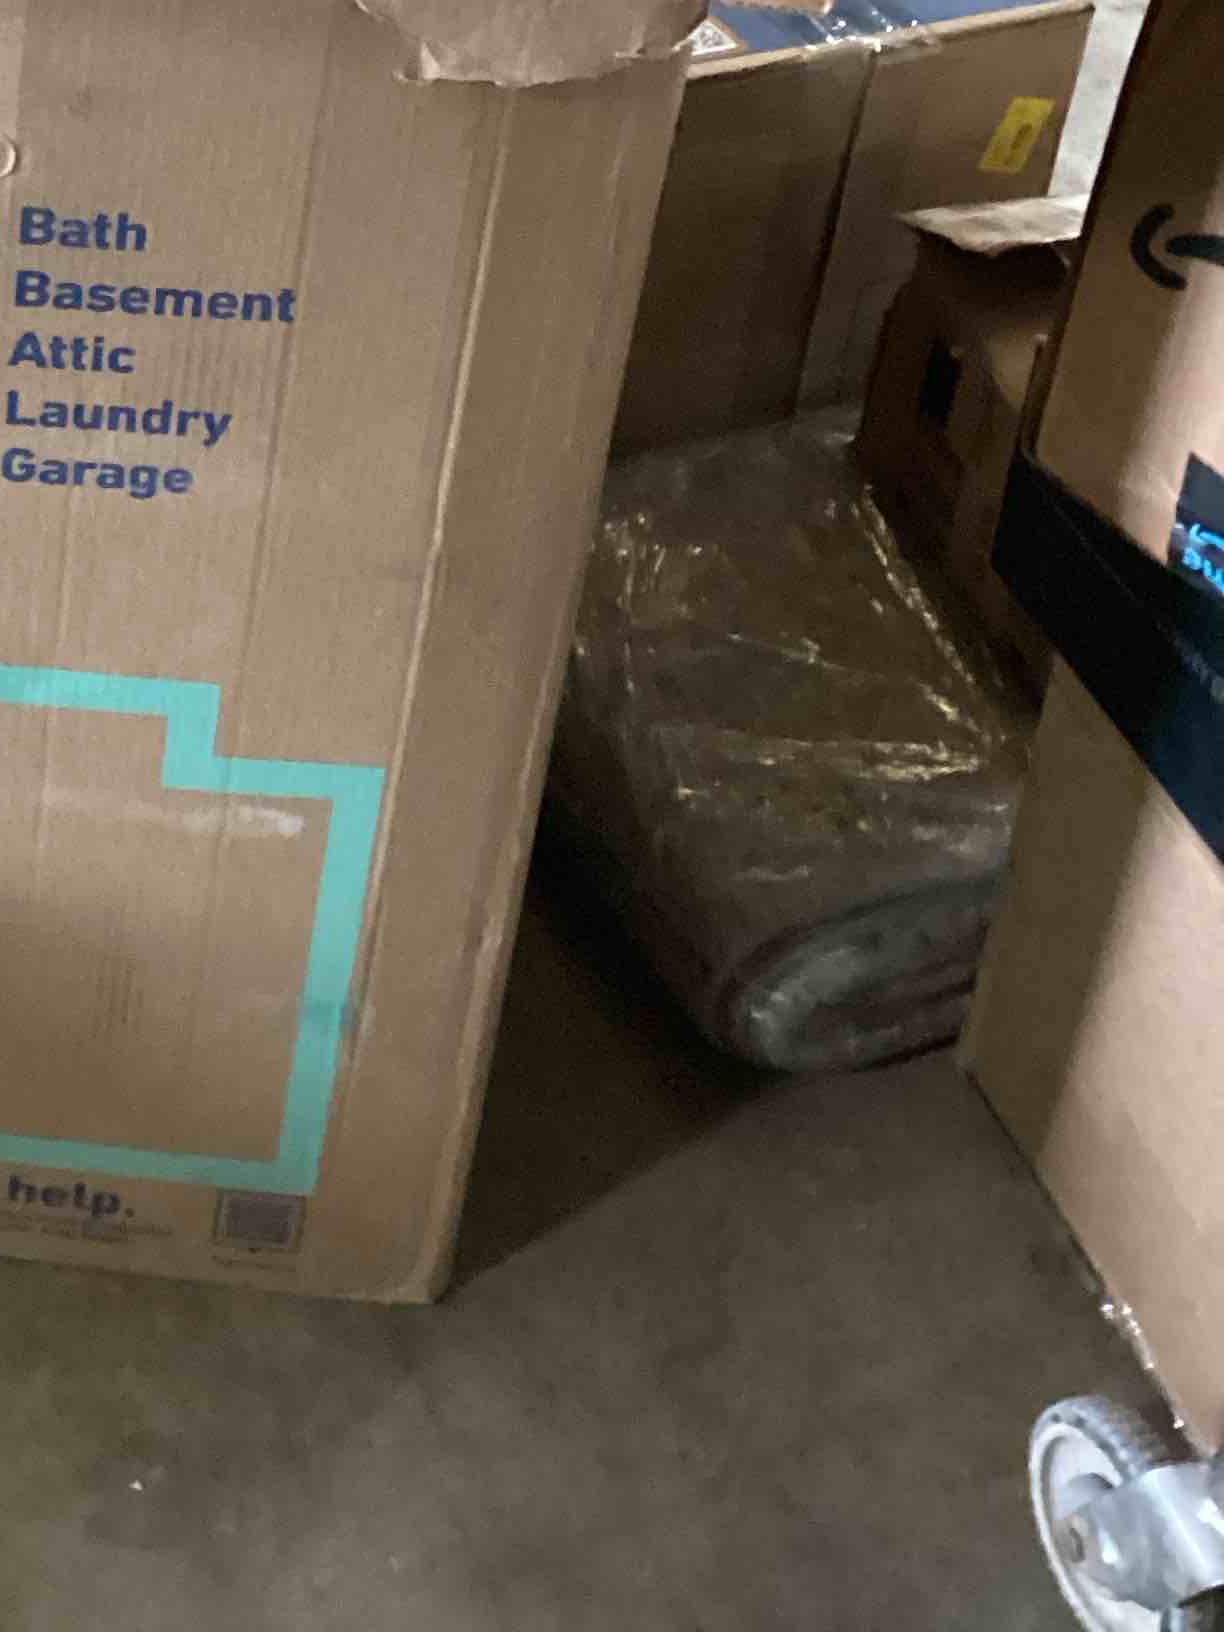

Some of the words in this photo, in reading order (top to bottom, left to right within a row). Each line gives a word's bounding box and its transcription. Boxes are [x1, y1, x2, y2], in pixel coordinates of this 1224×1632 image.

[18, 206, 148, 251] Bath
[14, 270, 296, 322] Basement
[8, 331, 136, 373] Attic
[5, 389, 233, 447] Laundry
[1, 447, 193, 499] Garage
[8, 1174, 135, 1218] help.
